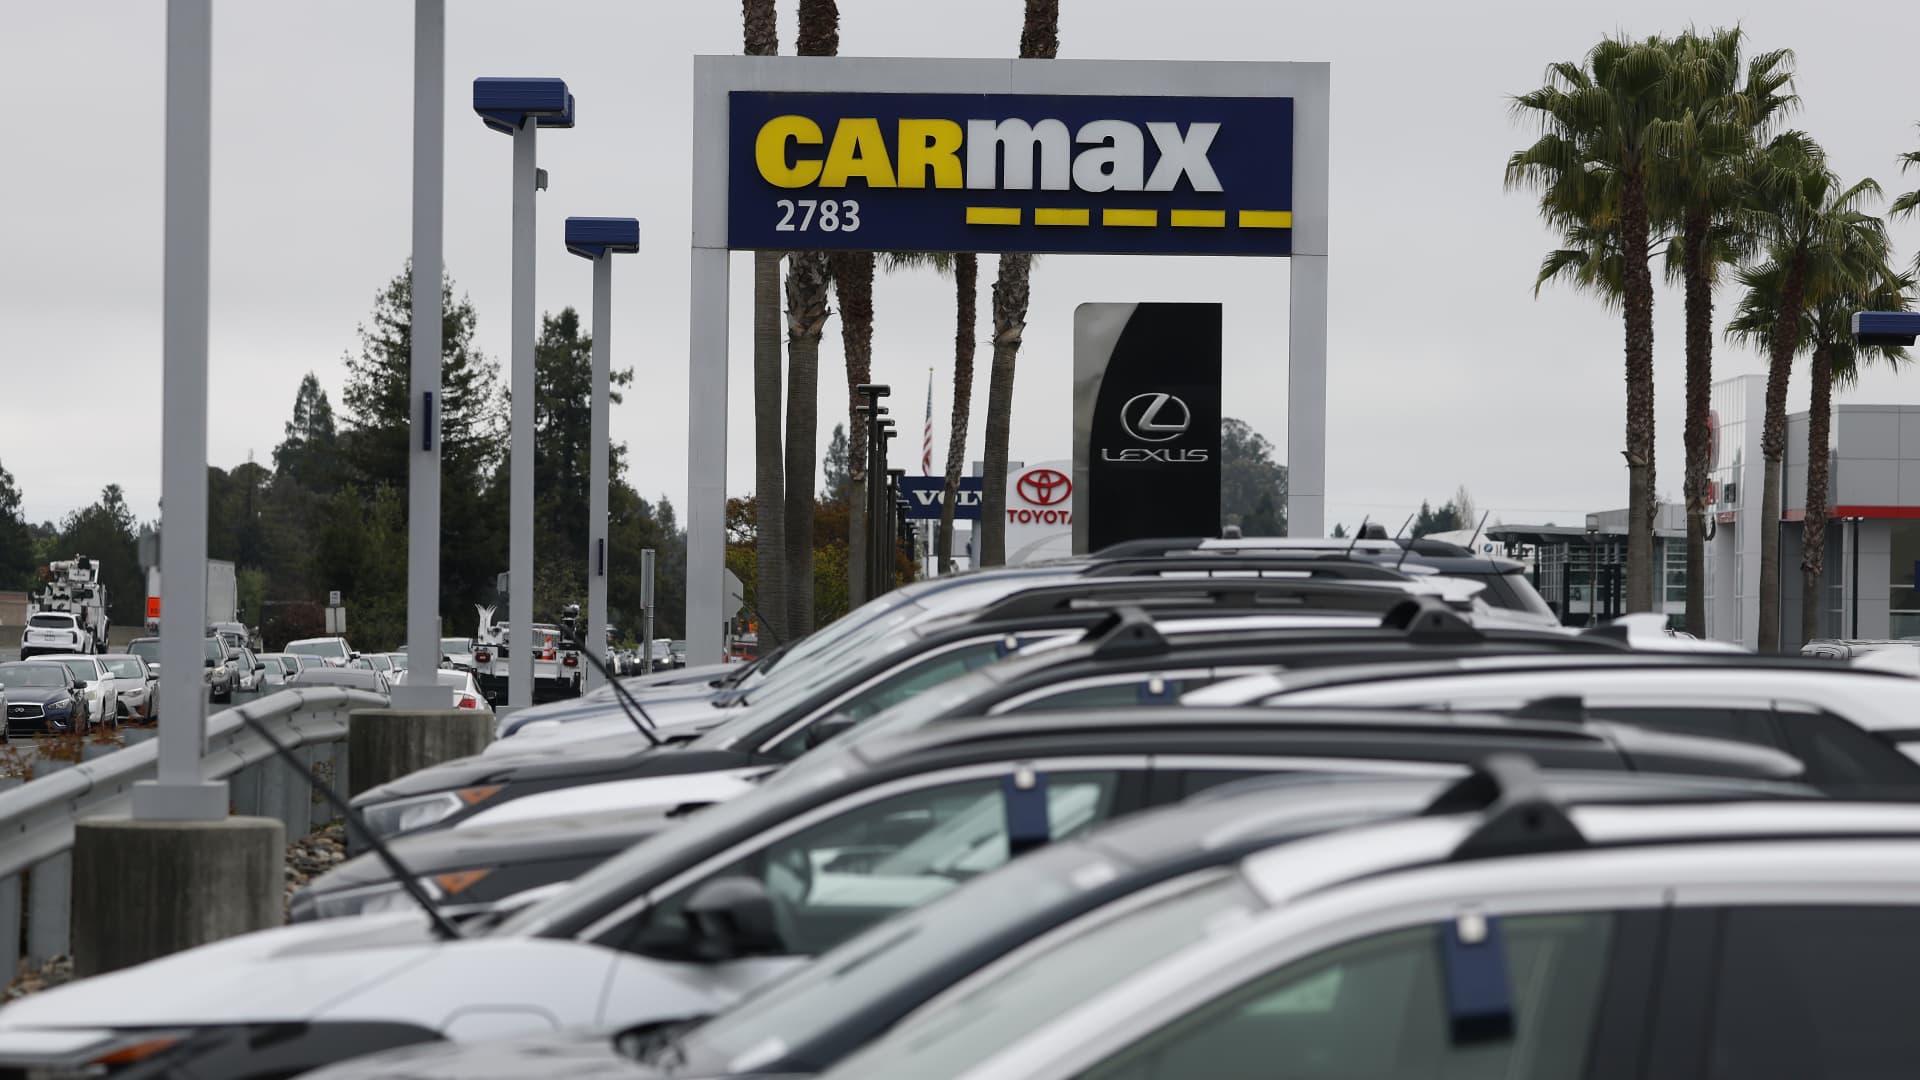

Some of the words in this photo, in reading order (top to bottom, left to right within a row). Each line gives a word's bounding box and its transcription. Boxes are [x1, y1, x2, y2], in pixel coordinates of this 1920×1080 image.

[756, 116, 1223, 192] CARmax
[776, 200, 860, 231] 2783
[1101, 448, 1208, 462] LEXUS
[1007, 509, 1072, 524] TOYOT
